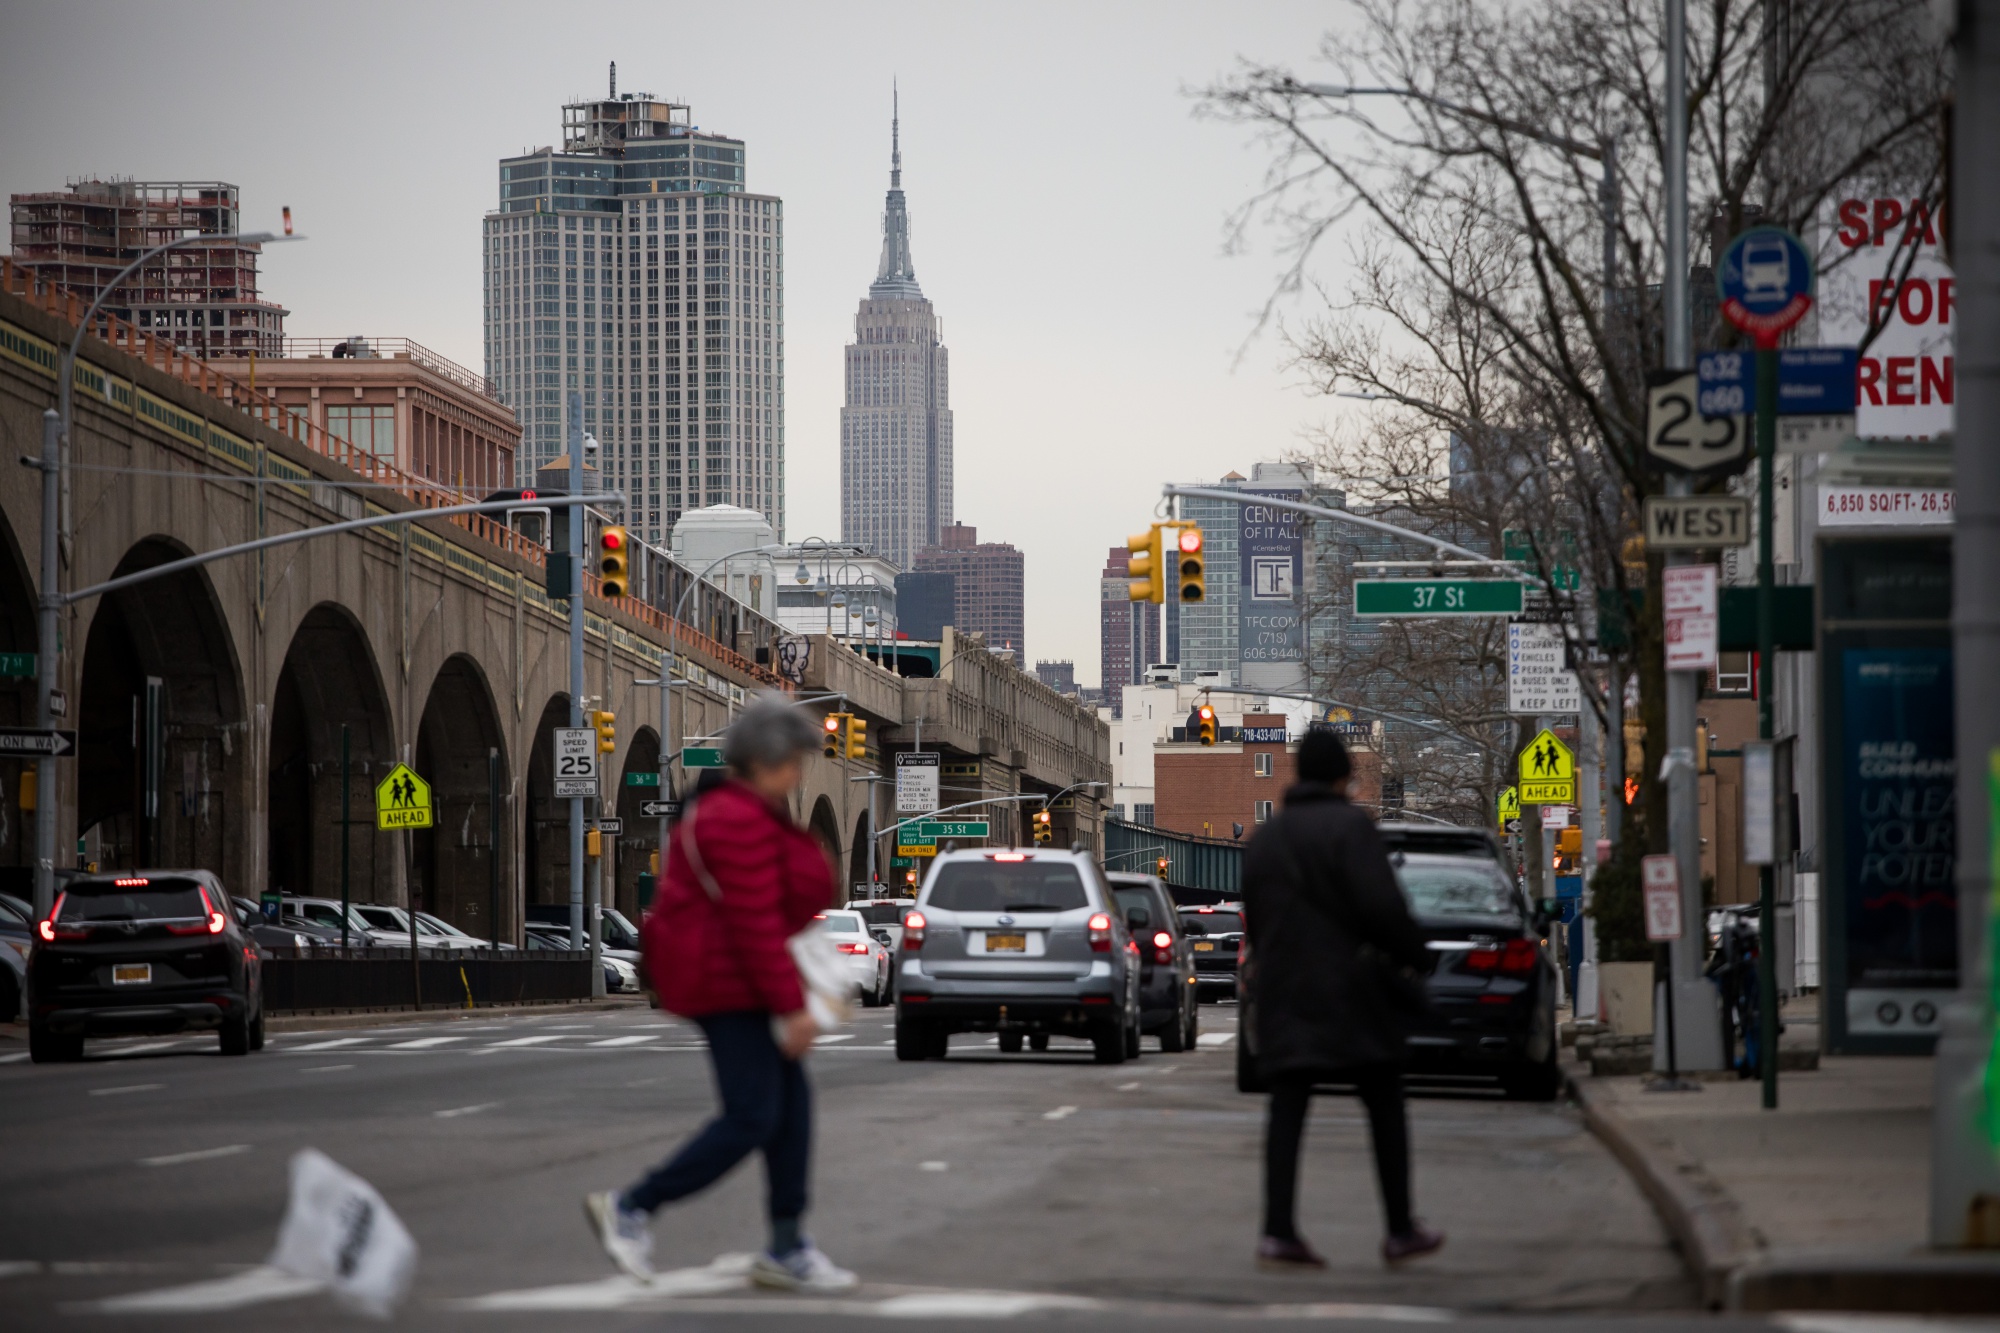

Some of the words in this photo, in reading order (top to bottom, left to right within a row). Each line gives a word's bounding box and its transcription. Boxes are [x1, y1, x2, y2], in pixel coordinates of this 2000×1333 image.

[1855, 356, 1955, 407] REN
[1828, 494, 1864, 514] 6,850
[1921, 492, 1957, 514] 26,50
[1245, 506, 1300, 523] CENTER
[1656, 507, 1742, 536] WEST
[1244, 527, 1261, 539] OF
[1265, 527, 1275, 539] IT
[1278, 527, 1300, 539] ALL
[1252, 544, 1291, 552] #CenterBlvd
[1413, 587, 1437, 607] 37
[1444, 587, 1465, 608] St
[1245, 616, 1300, 628] TFC.COM
[1258, 631, 1287, 645] (718)
[1243, 647, 1302, 659] 606-9440
[1520, 698, 1547, 709] KEEP
[1552, 698, 1578, 709] LEFT
[1243, 728, 1285, 741] 718-433-0077
[3, 736, 25, 748] ONE
[35, 737, 60, 748] WAY
[560, 756, 592, 775] 25
[635, 775, 644, 784] 36
[1526, 786, 1568, 798] AHEAD
[386, 811, 424, 825] AHEAD
[942, 825, 953, 834] 35
[956, 825, 966, 834] St
